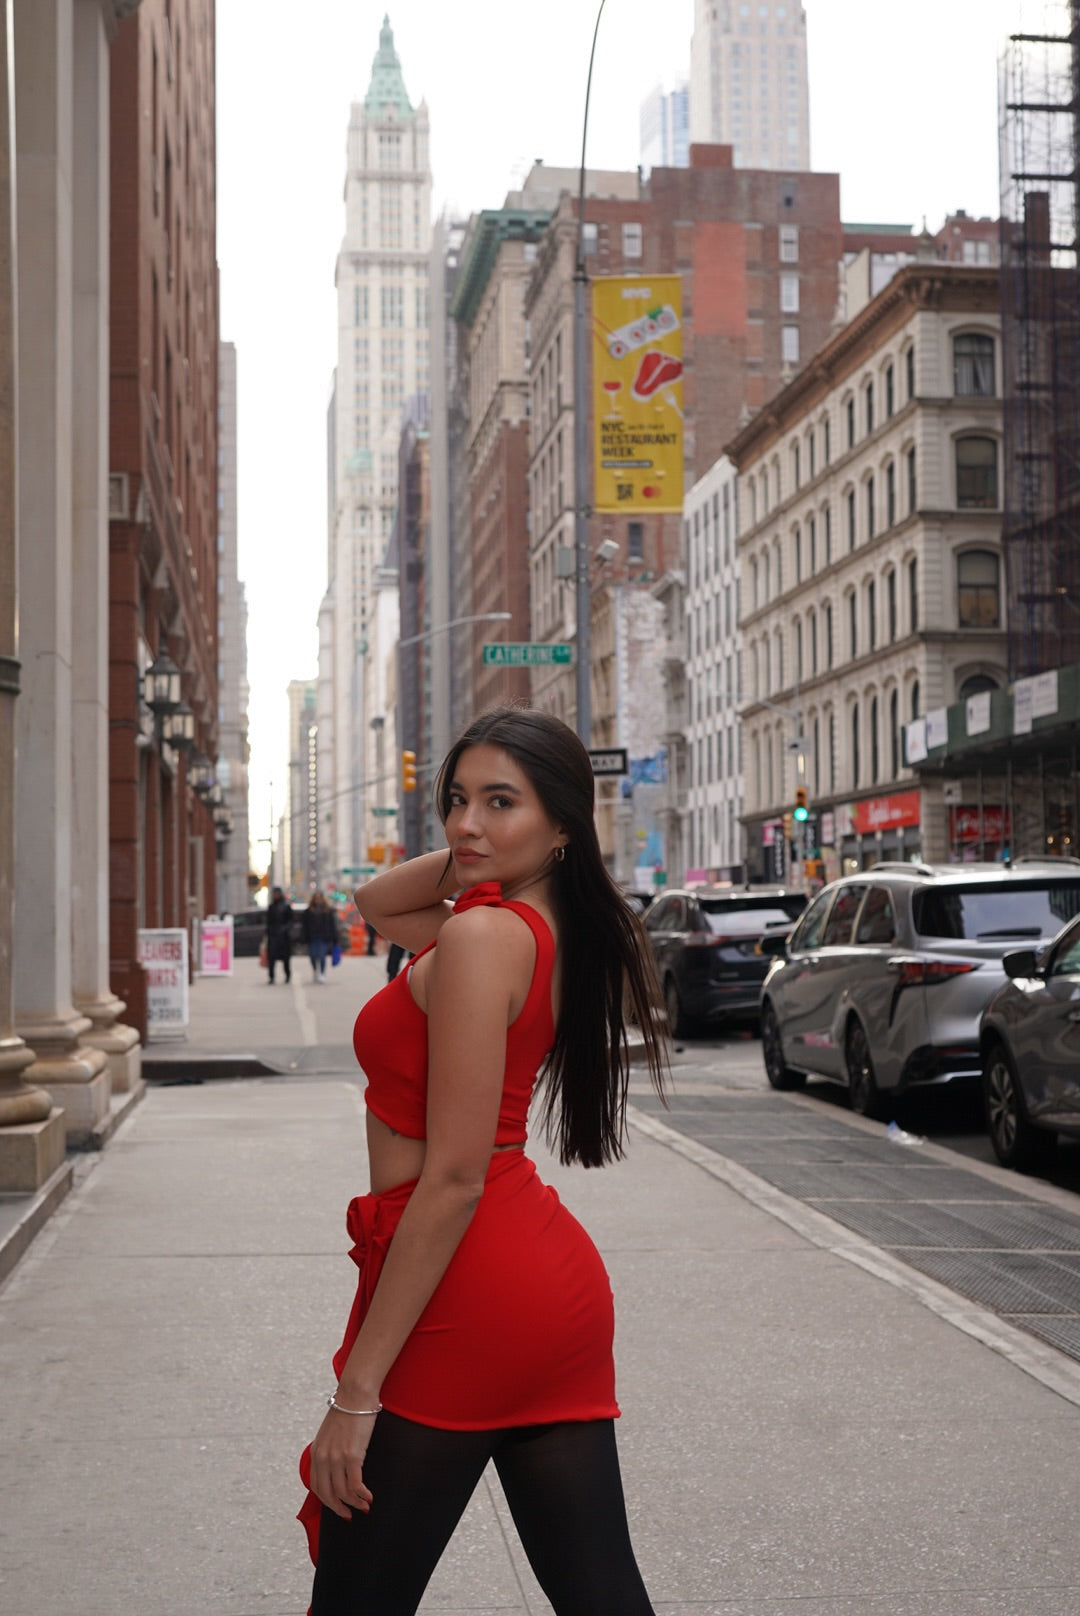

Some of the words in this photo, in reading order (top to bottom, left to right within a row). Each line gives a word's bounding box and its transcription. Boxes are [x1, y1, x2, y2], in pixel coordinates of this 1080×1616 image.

[601, 422, 625, 433] NYC
[602, 433, 677, 445] RESTAURANT
[602, 447, 635, 457] WEEK
[486, 646, 553, 663] CATHERINE
[591, 758, 617, 767] WAY
[140, 942, 182, 961] LEANERS
